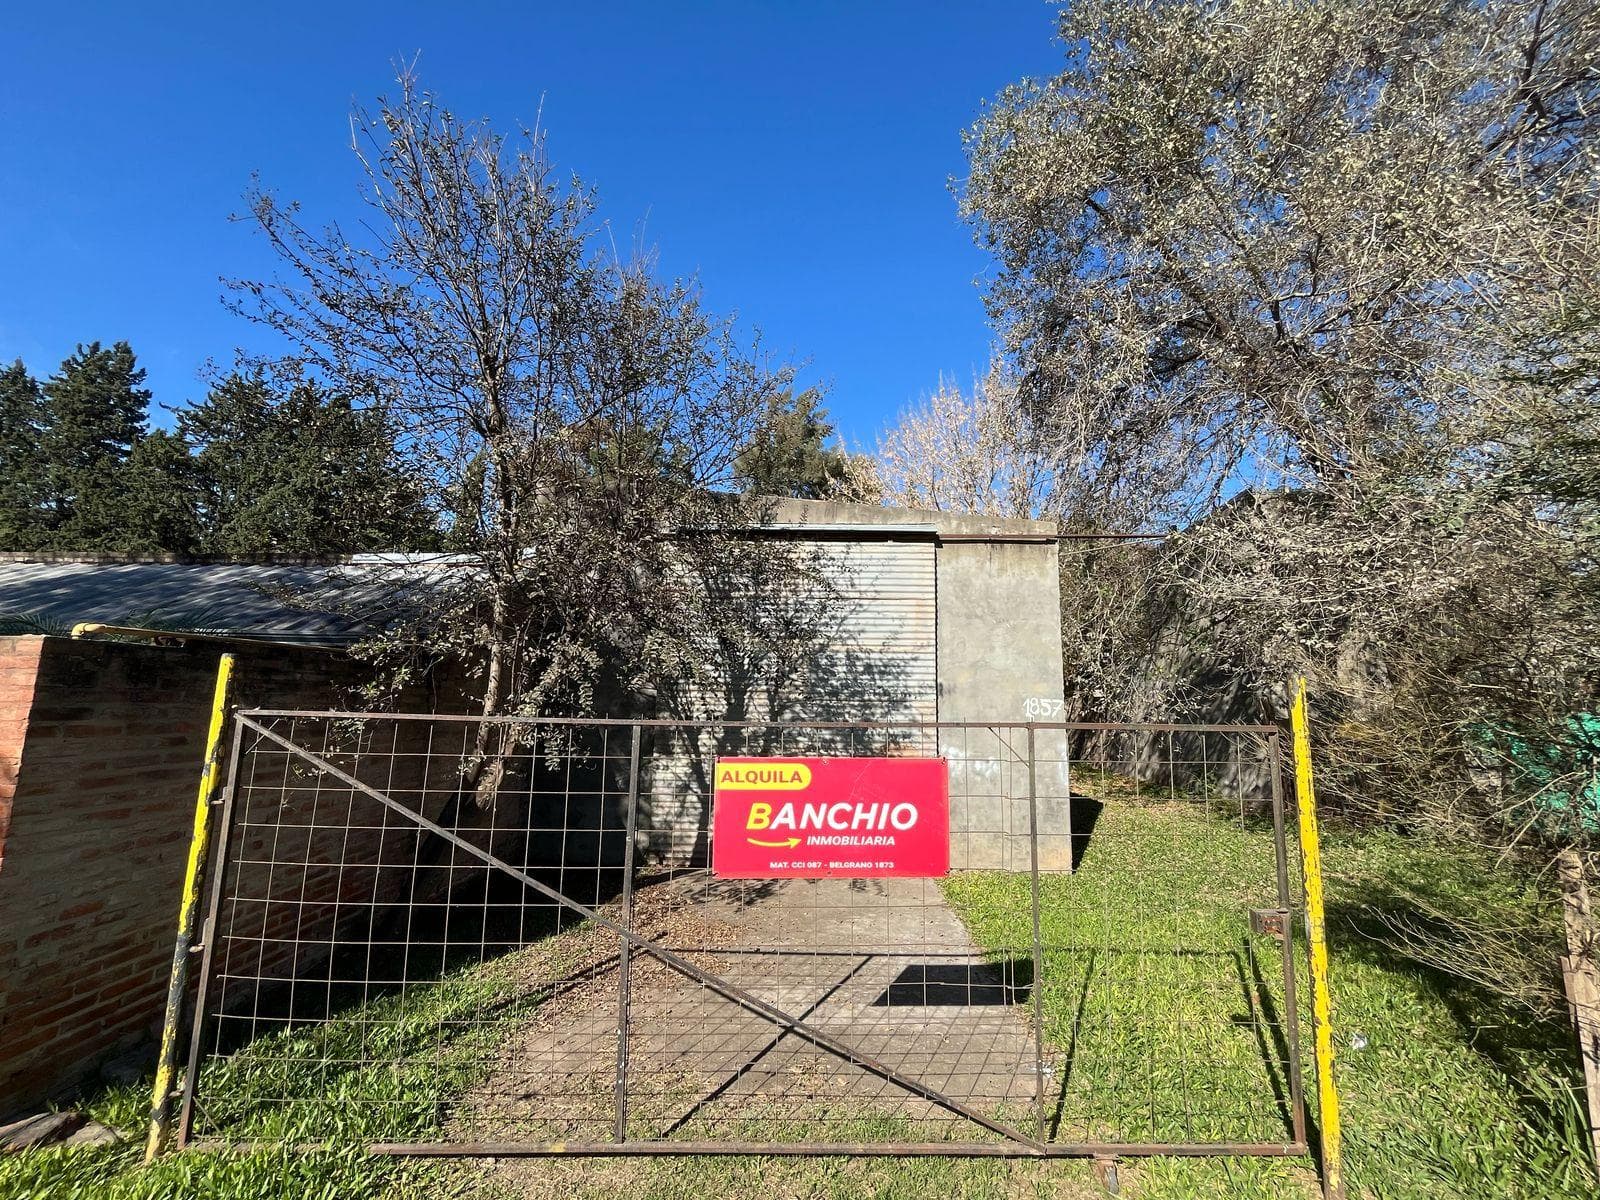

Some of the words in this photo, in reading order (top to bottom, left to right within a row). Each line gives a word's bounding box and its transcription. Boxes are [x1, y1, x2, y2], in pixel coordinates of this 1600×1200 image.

[1023, 698, 1064, 717] 1857
[721, 770, 803, 784] ALQUILA
[746, 802, 919, 830] BANCHIO
[806, 835, 896, 846] INMOBILIARIA
[769, 861, 790, 869] MAT.
[791, 861, 805, 869] CCI
[829, 861, 873, 869] BELGRANO
